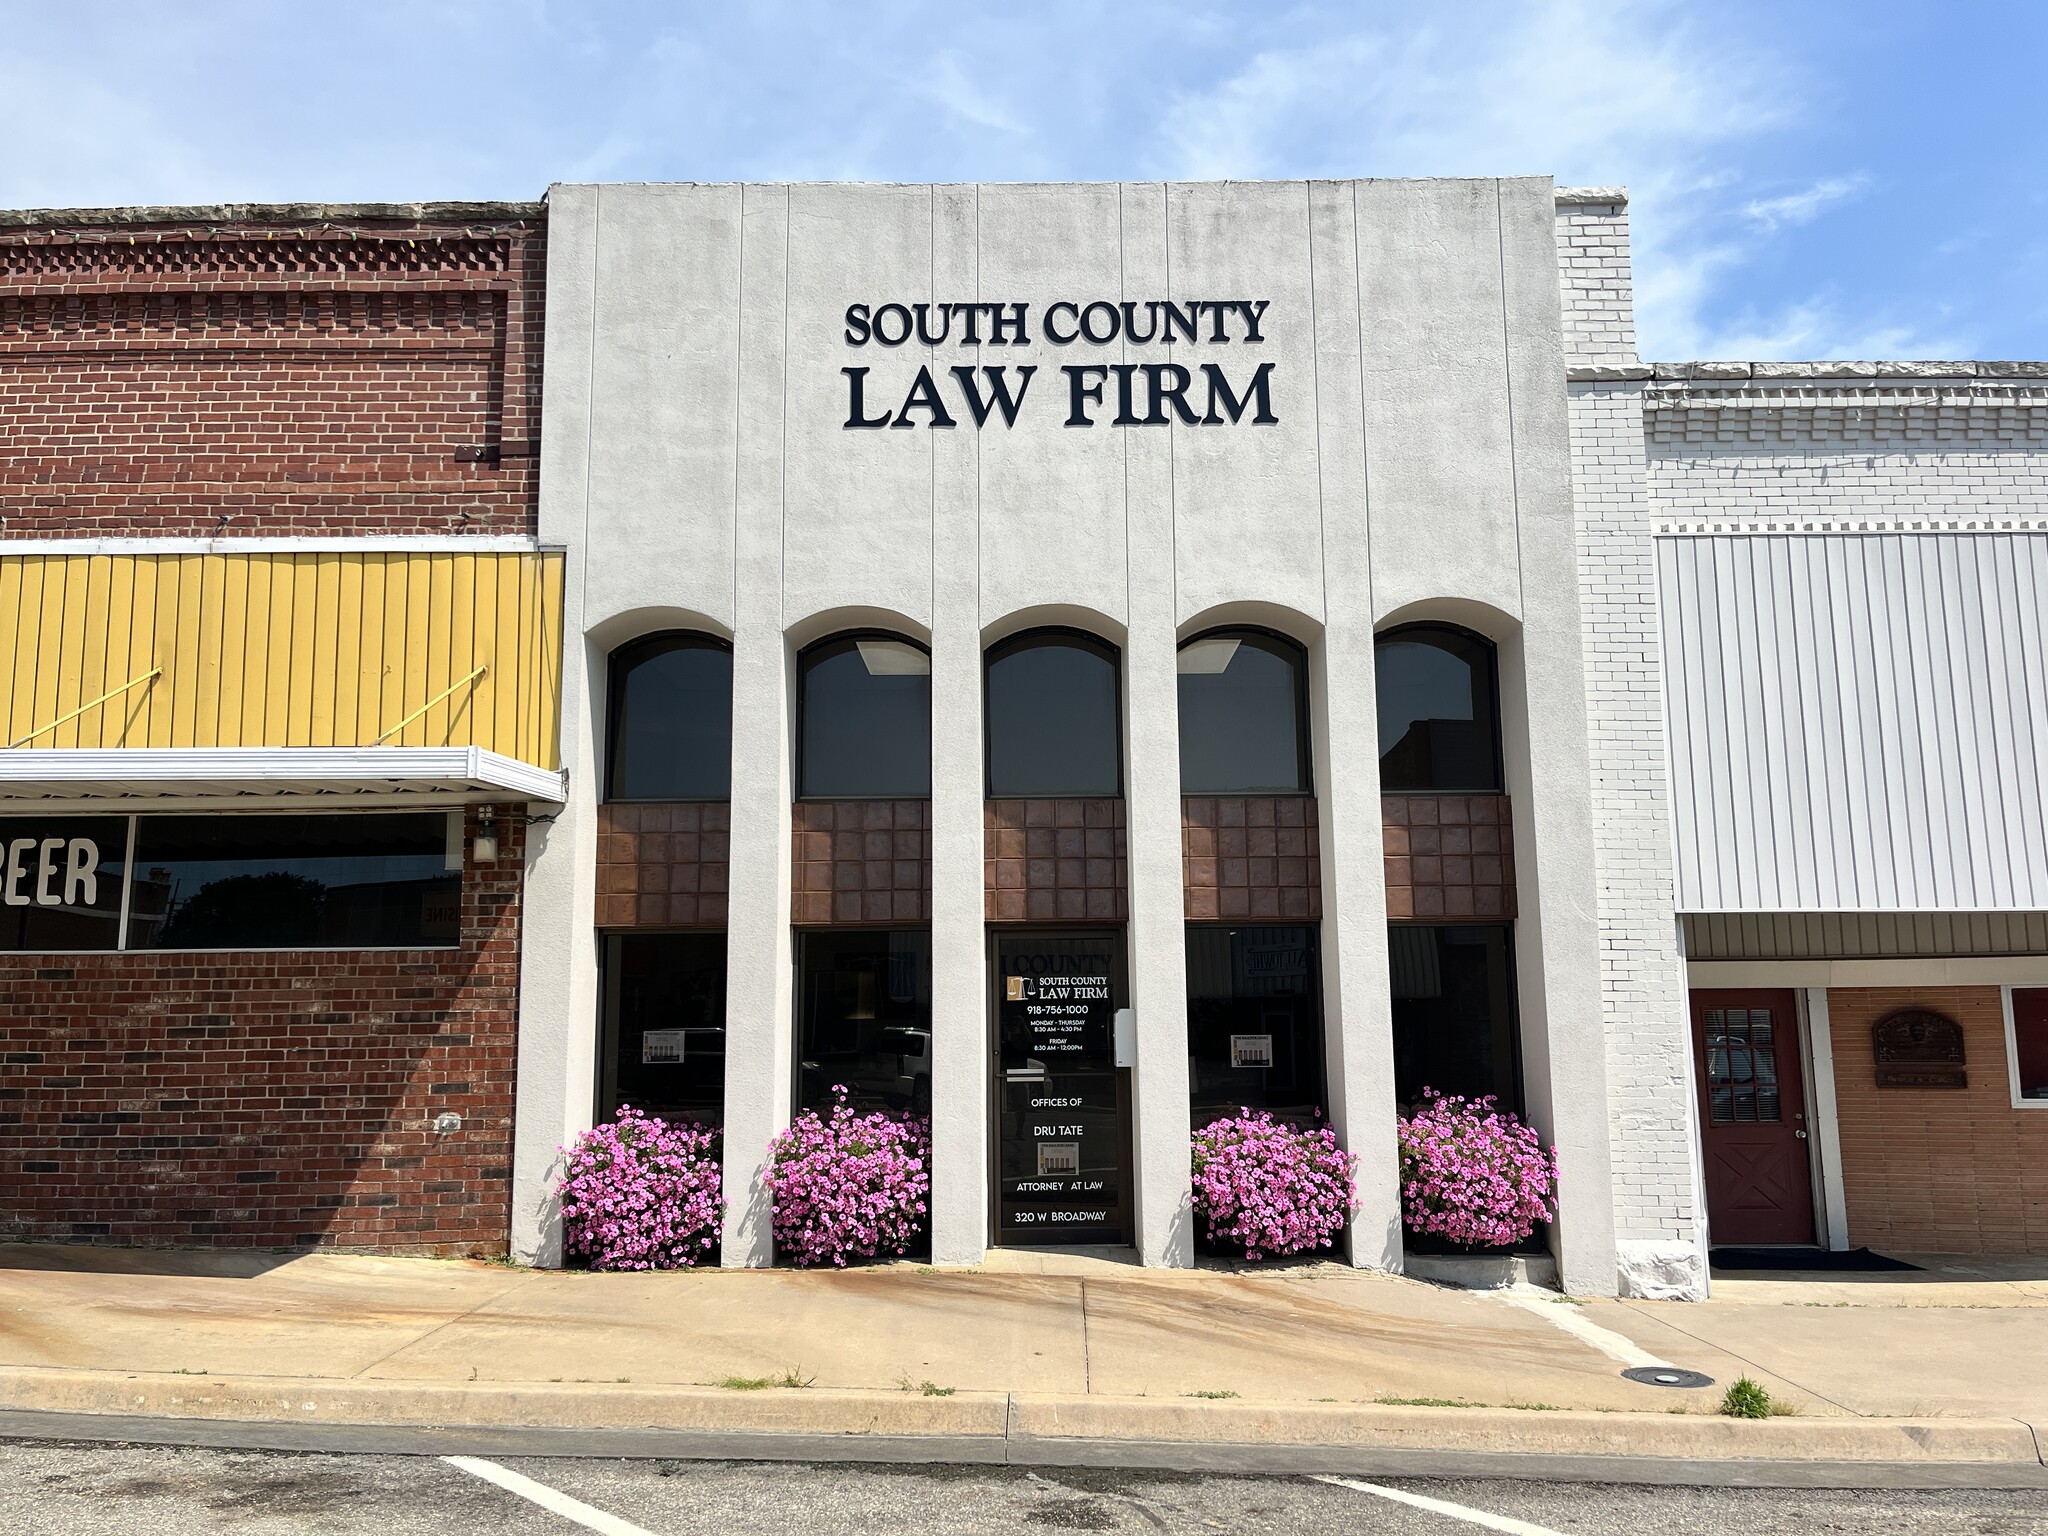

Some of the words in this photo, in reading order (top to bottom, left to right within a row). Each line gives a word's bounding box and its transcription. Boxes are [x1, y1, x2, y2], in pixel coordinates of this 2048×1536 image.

[844, 303, 1031, 345] SOUTH
[1043, 300, 1270, 344] COUNTY
[841, 364, 1038, 428] LAW
[1060, 362, 1279, 427] FIRM
[0, 838, 99, 905] EER
[1013, 954, 1113, 974] COUNTY
[1039, 977, 1069, 985] SOUTH
[1070, 977, 1107, 985] COUNTY
[1039, 987, 1071, 999] LAW
[1074, 987, 1108, 999] FIRM
[1027, 1005, 1089, 1014] 918-756-1000
[1031, 1098, 1068, 1107] OFFICES
[1069, 1097, 1083, 1106] OF
[1034, 1126, 1056, 1136] DRU
[1058, 1125, 1083, 1136] TATE
[1016, 1182, 1064, 1191] ATTORNEY
[1070, 1181, 1082, 1190] AT
[1084, 1181, 1103, 1190] LAW
[1014, 1212, 1035, 1222] 320
[1037, 1212, 1047, 1221] W
[1051, 1211, 1107, 1221] BROADWAY
